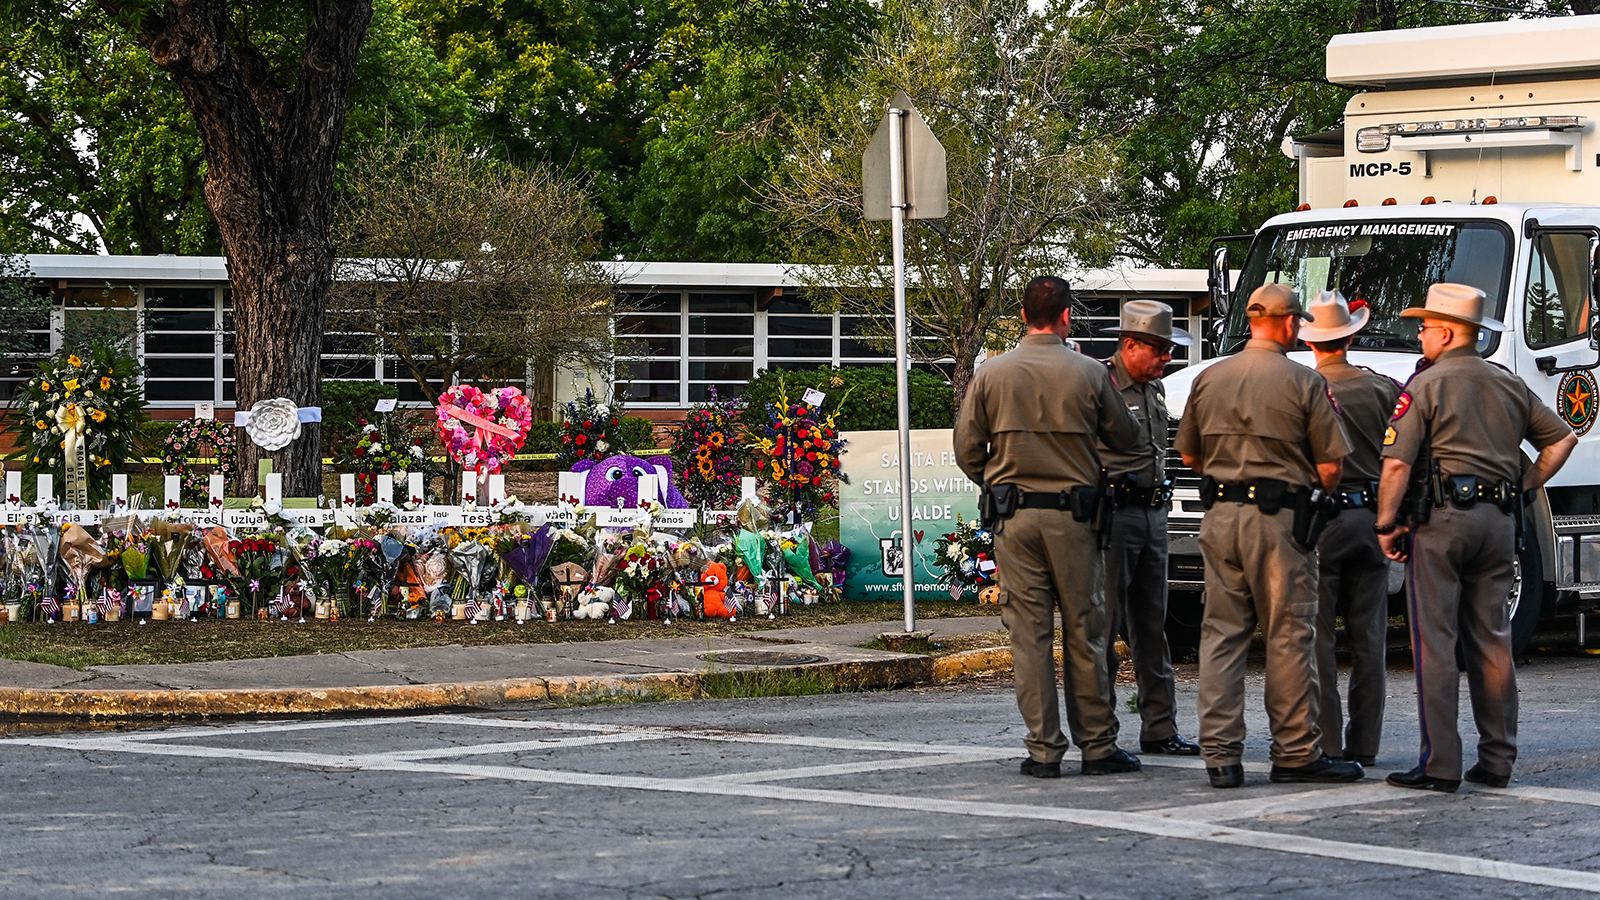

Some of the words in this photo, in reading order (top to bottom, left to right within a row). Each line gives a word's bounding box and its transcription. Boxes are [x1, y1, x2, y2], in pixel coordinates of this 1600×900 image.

[1350, 162, 1411, 177] MCP-5
[1286, 225, 1359, 241] EMERGENCY
[1360, 224, 1454, 236] MANAGEMENT
[881, 452, 935, 468] SATA
[933, 478, 974, 493] WITH
[78, 489, 86, 510] LAND
[389, 514, 428, 524] alazar
[461, 514, 493, 524] Tess
[888, 505, 951, 520] UALDE
